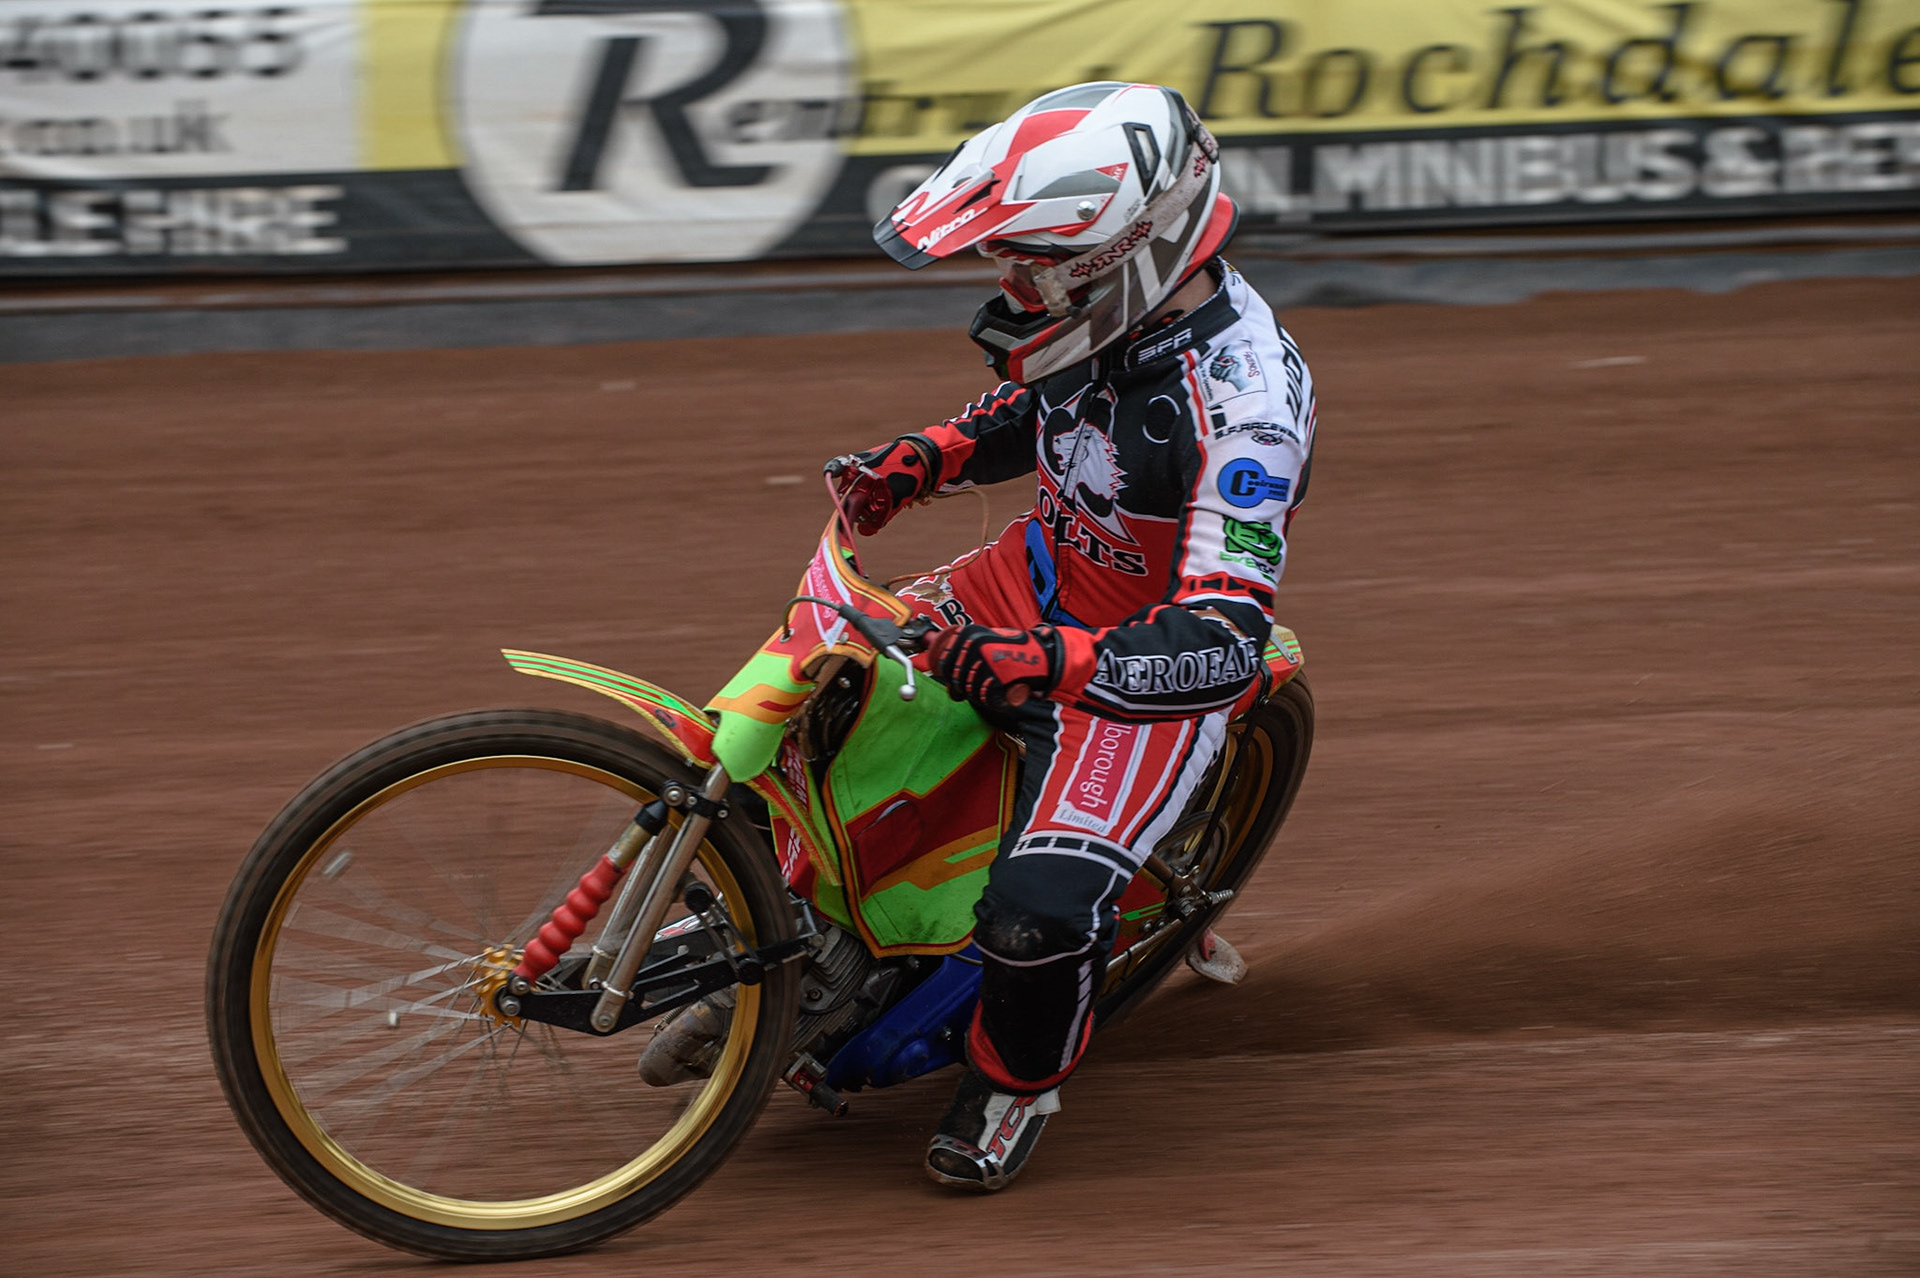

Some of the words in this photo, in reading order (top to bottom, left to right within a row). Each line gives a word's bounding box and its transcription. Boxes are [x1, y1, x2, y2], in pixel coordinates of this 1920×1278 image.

[916, 207, 985, 253] Nitro
[1038, 484, 1149, 577] OLTS
[1078, 721, 1133, 811] lborough
[1057, 806, 1108, 834] Limited
